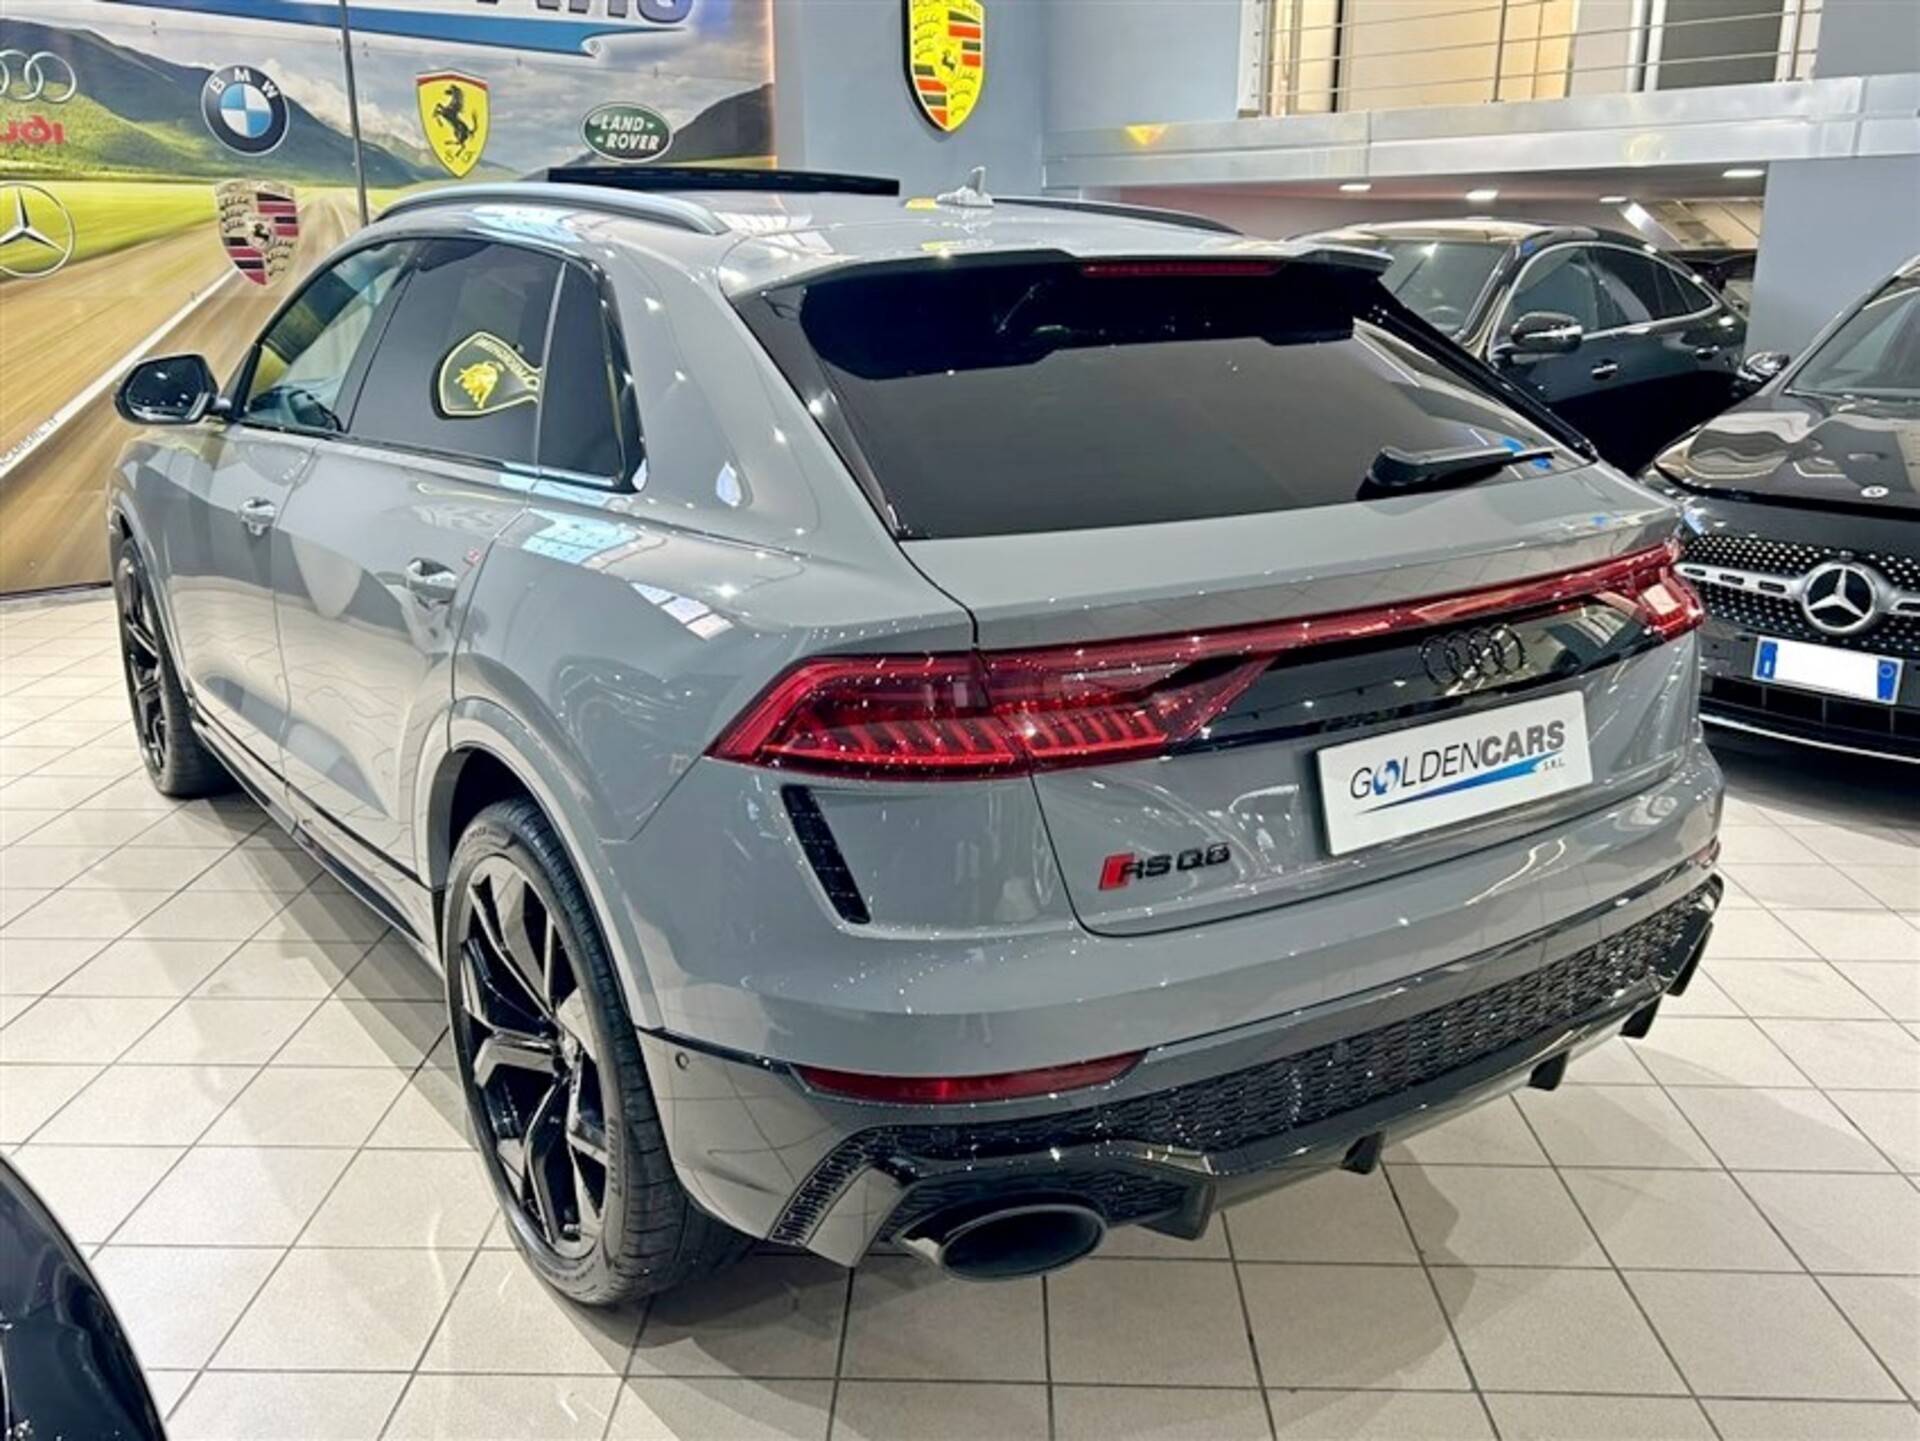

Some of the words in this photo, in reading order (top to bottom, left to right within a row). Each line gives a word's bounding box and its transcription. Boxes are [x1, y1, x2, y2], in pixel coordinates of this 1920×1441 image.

[209, 67, 278, 99] BMW
[0, 113, 65, 145] udi
[601, 115, 645, 132] LAND
[605, 132, 660, 150] ROVER
